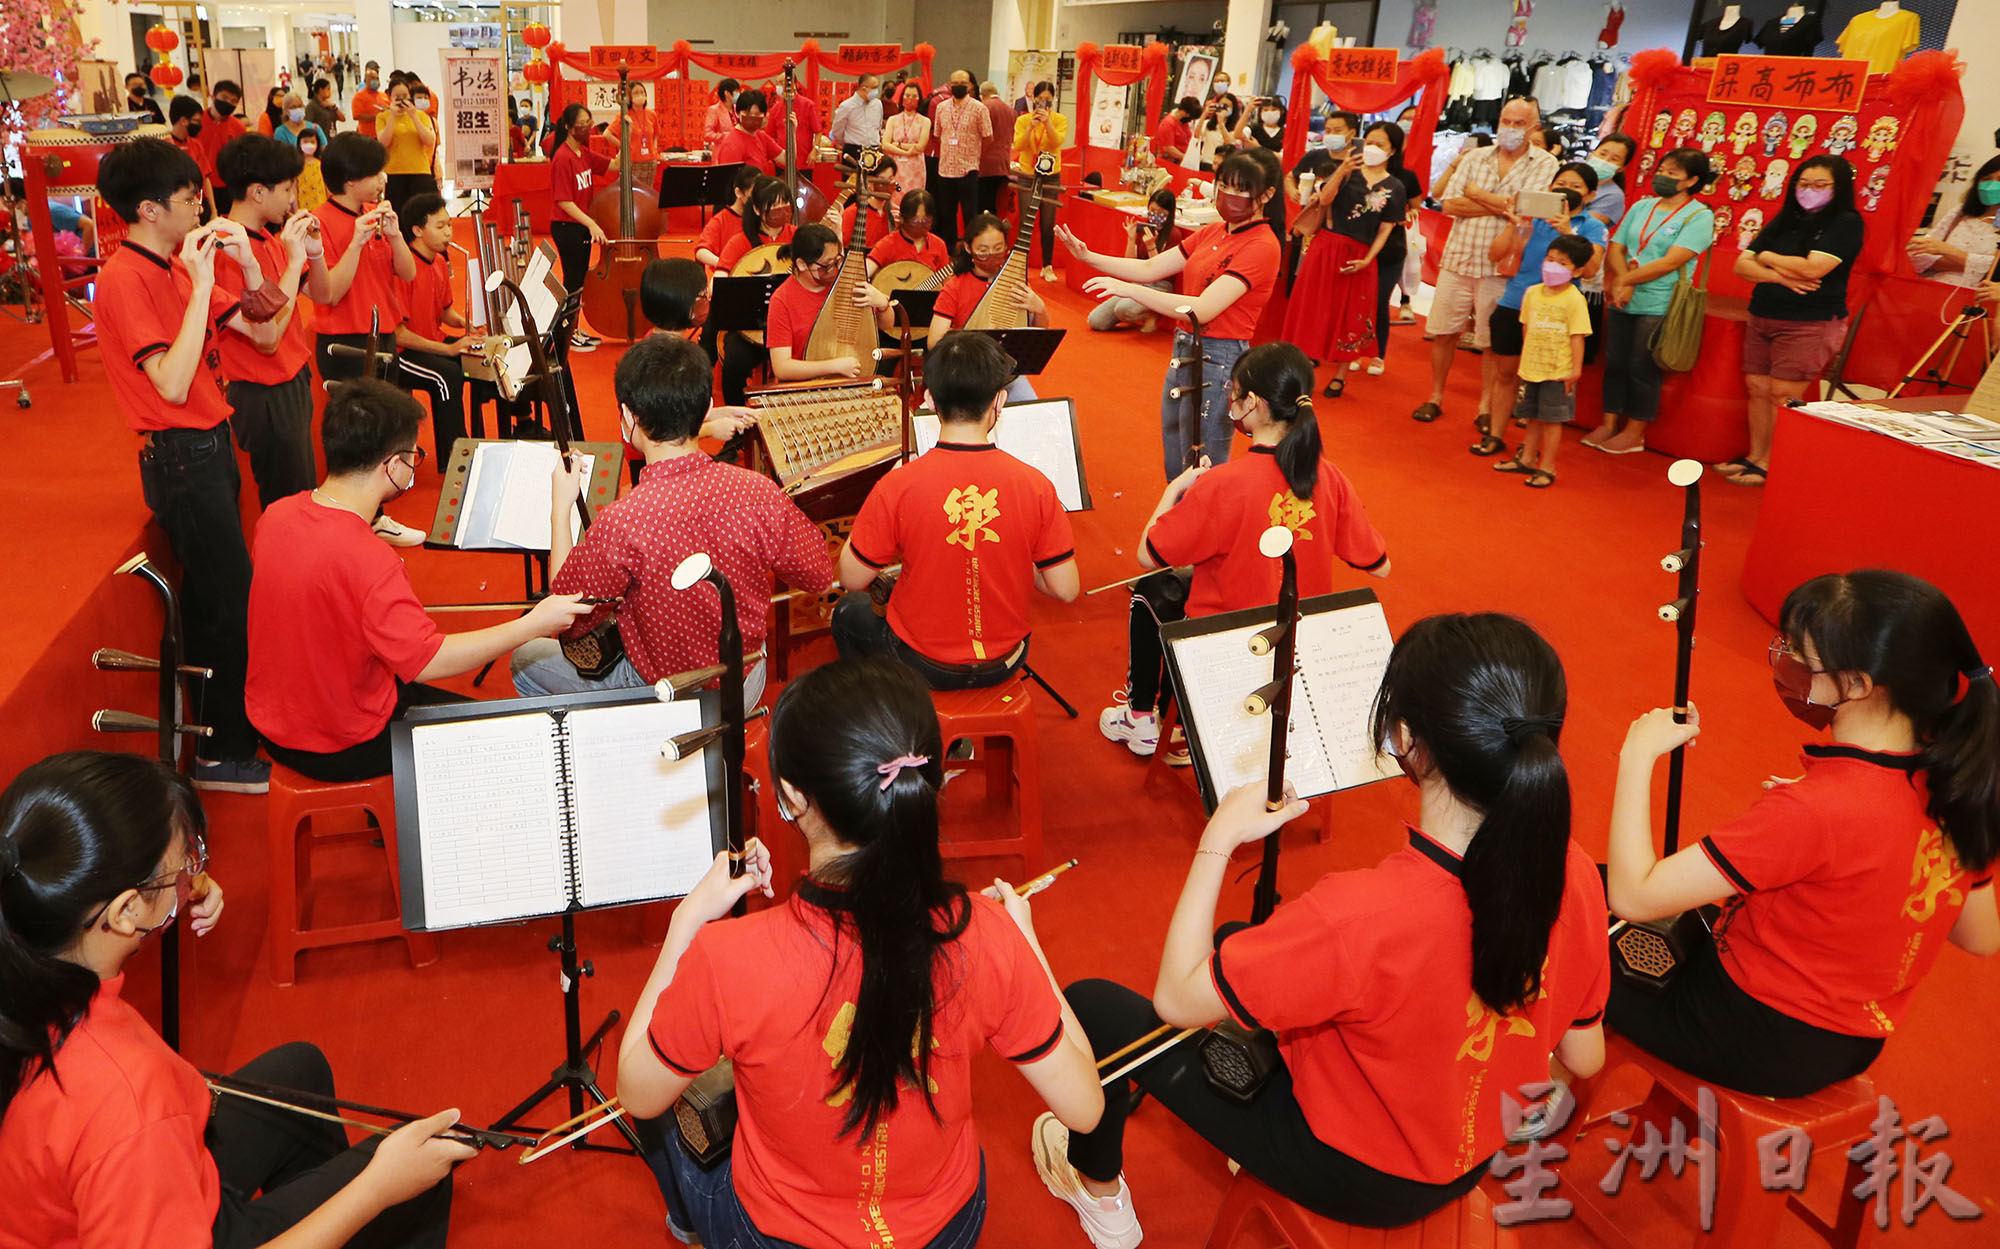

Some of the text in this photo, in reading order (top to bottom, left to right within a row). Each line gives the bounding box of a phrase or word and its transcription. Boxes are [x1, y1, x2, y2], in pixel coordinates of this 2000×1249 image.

[452, 66, 497, 96] 书法
[457, 111, 490, 129] 招生
[943, 484, 1001, 551] 樂
